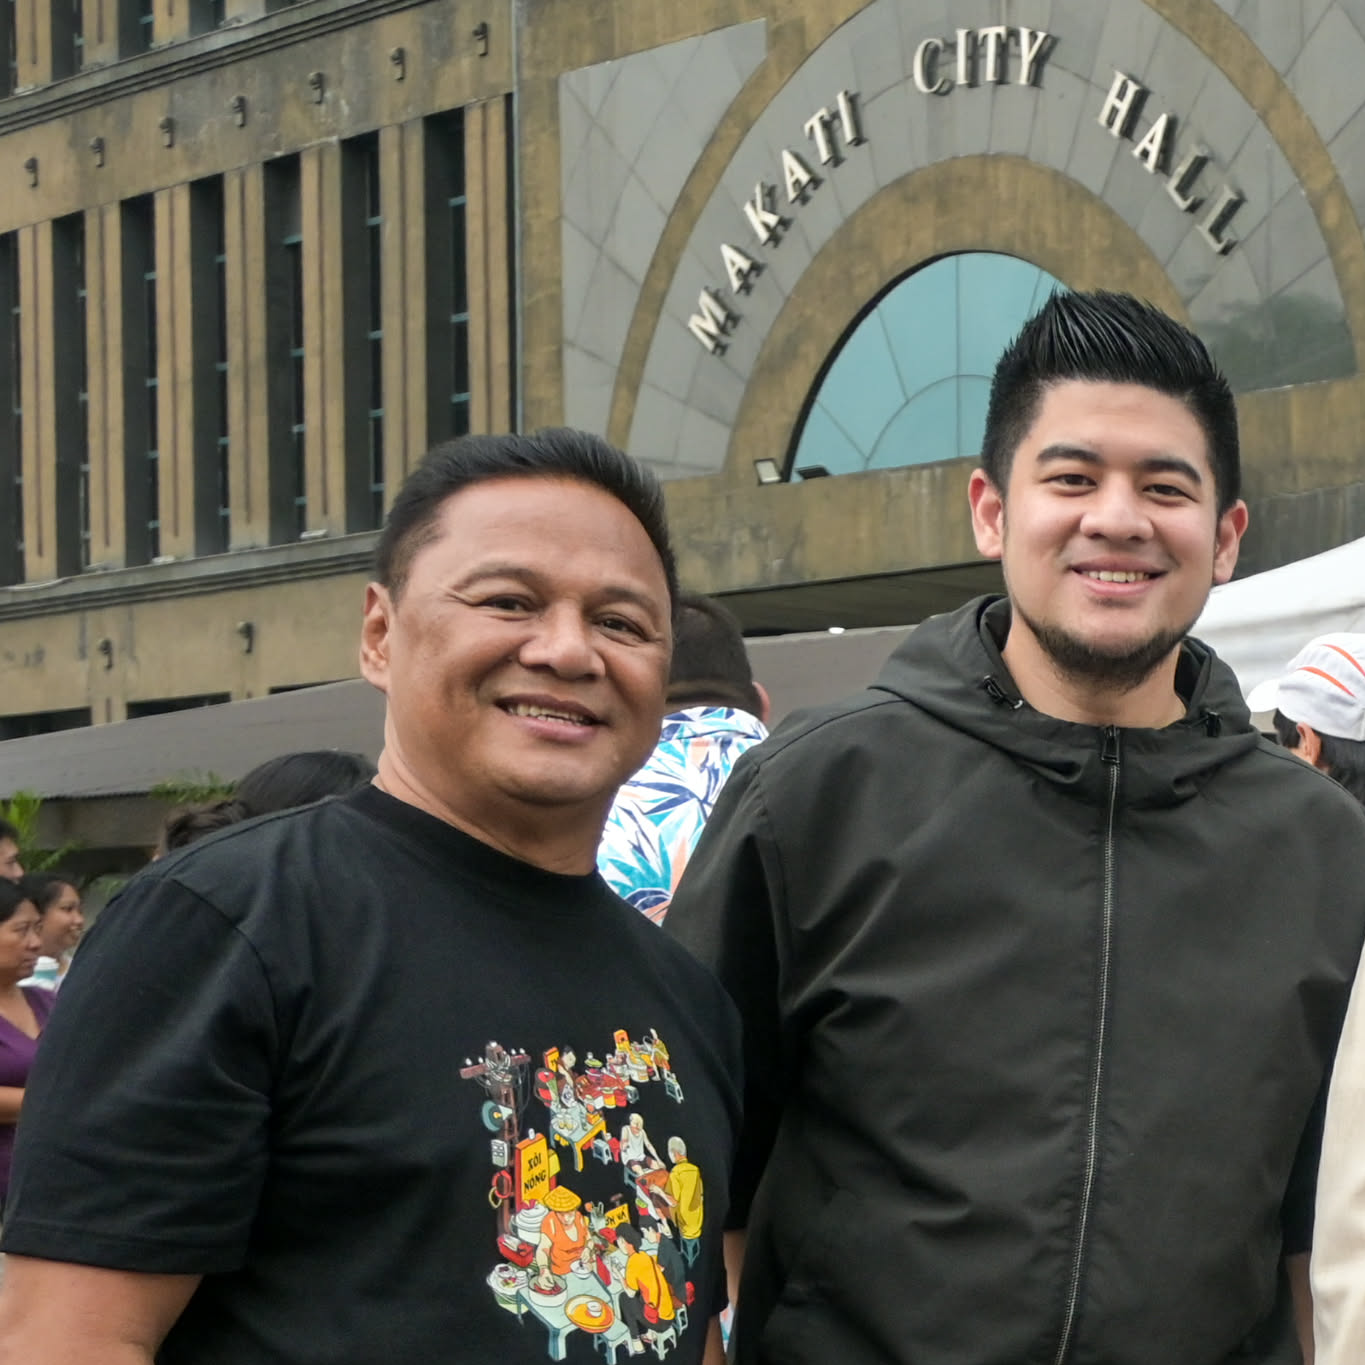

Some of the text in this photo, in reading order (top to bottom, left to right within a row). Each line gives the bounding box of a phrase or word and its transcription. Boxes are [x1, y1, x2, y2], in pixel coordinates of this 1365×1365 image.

[687, 26, 1248, 357] MAKATI CITY HALL
